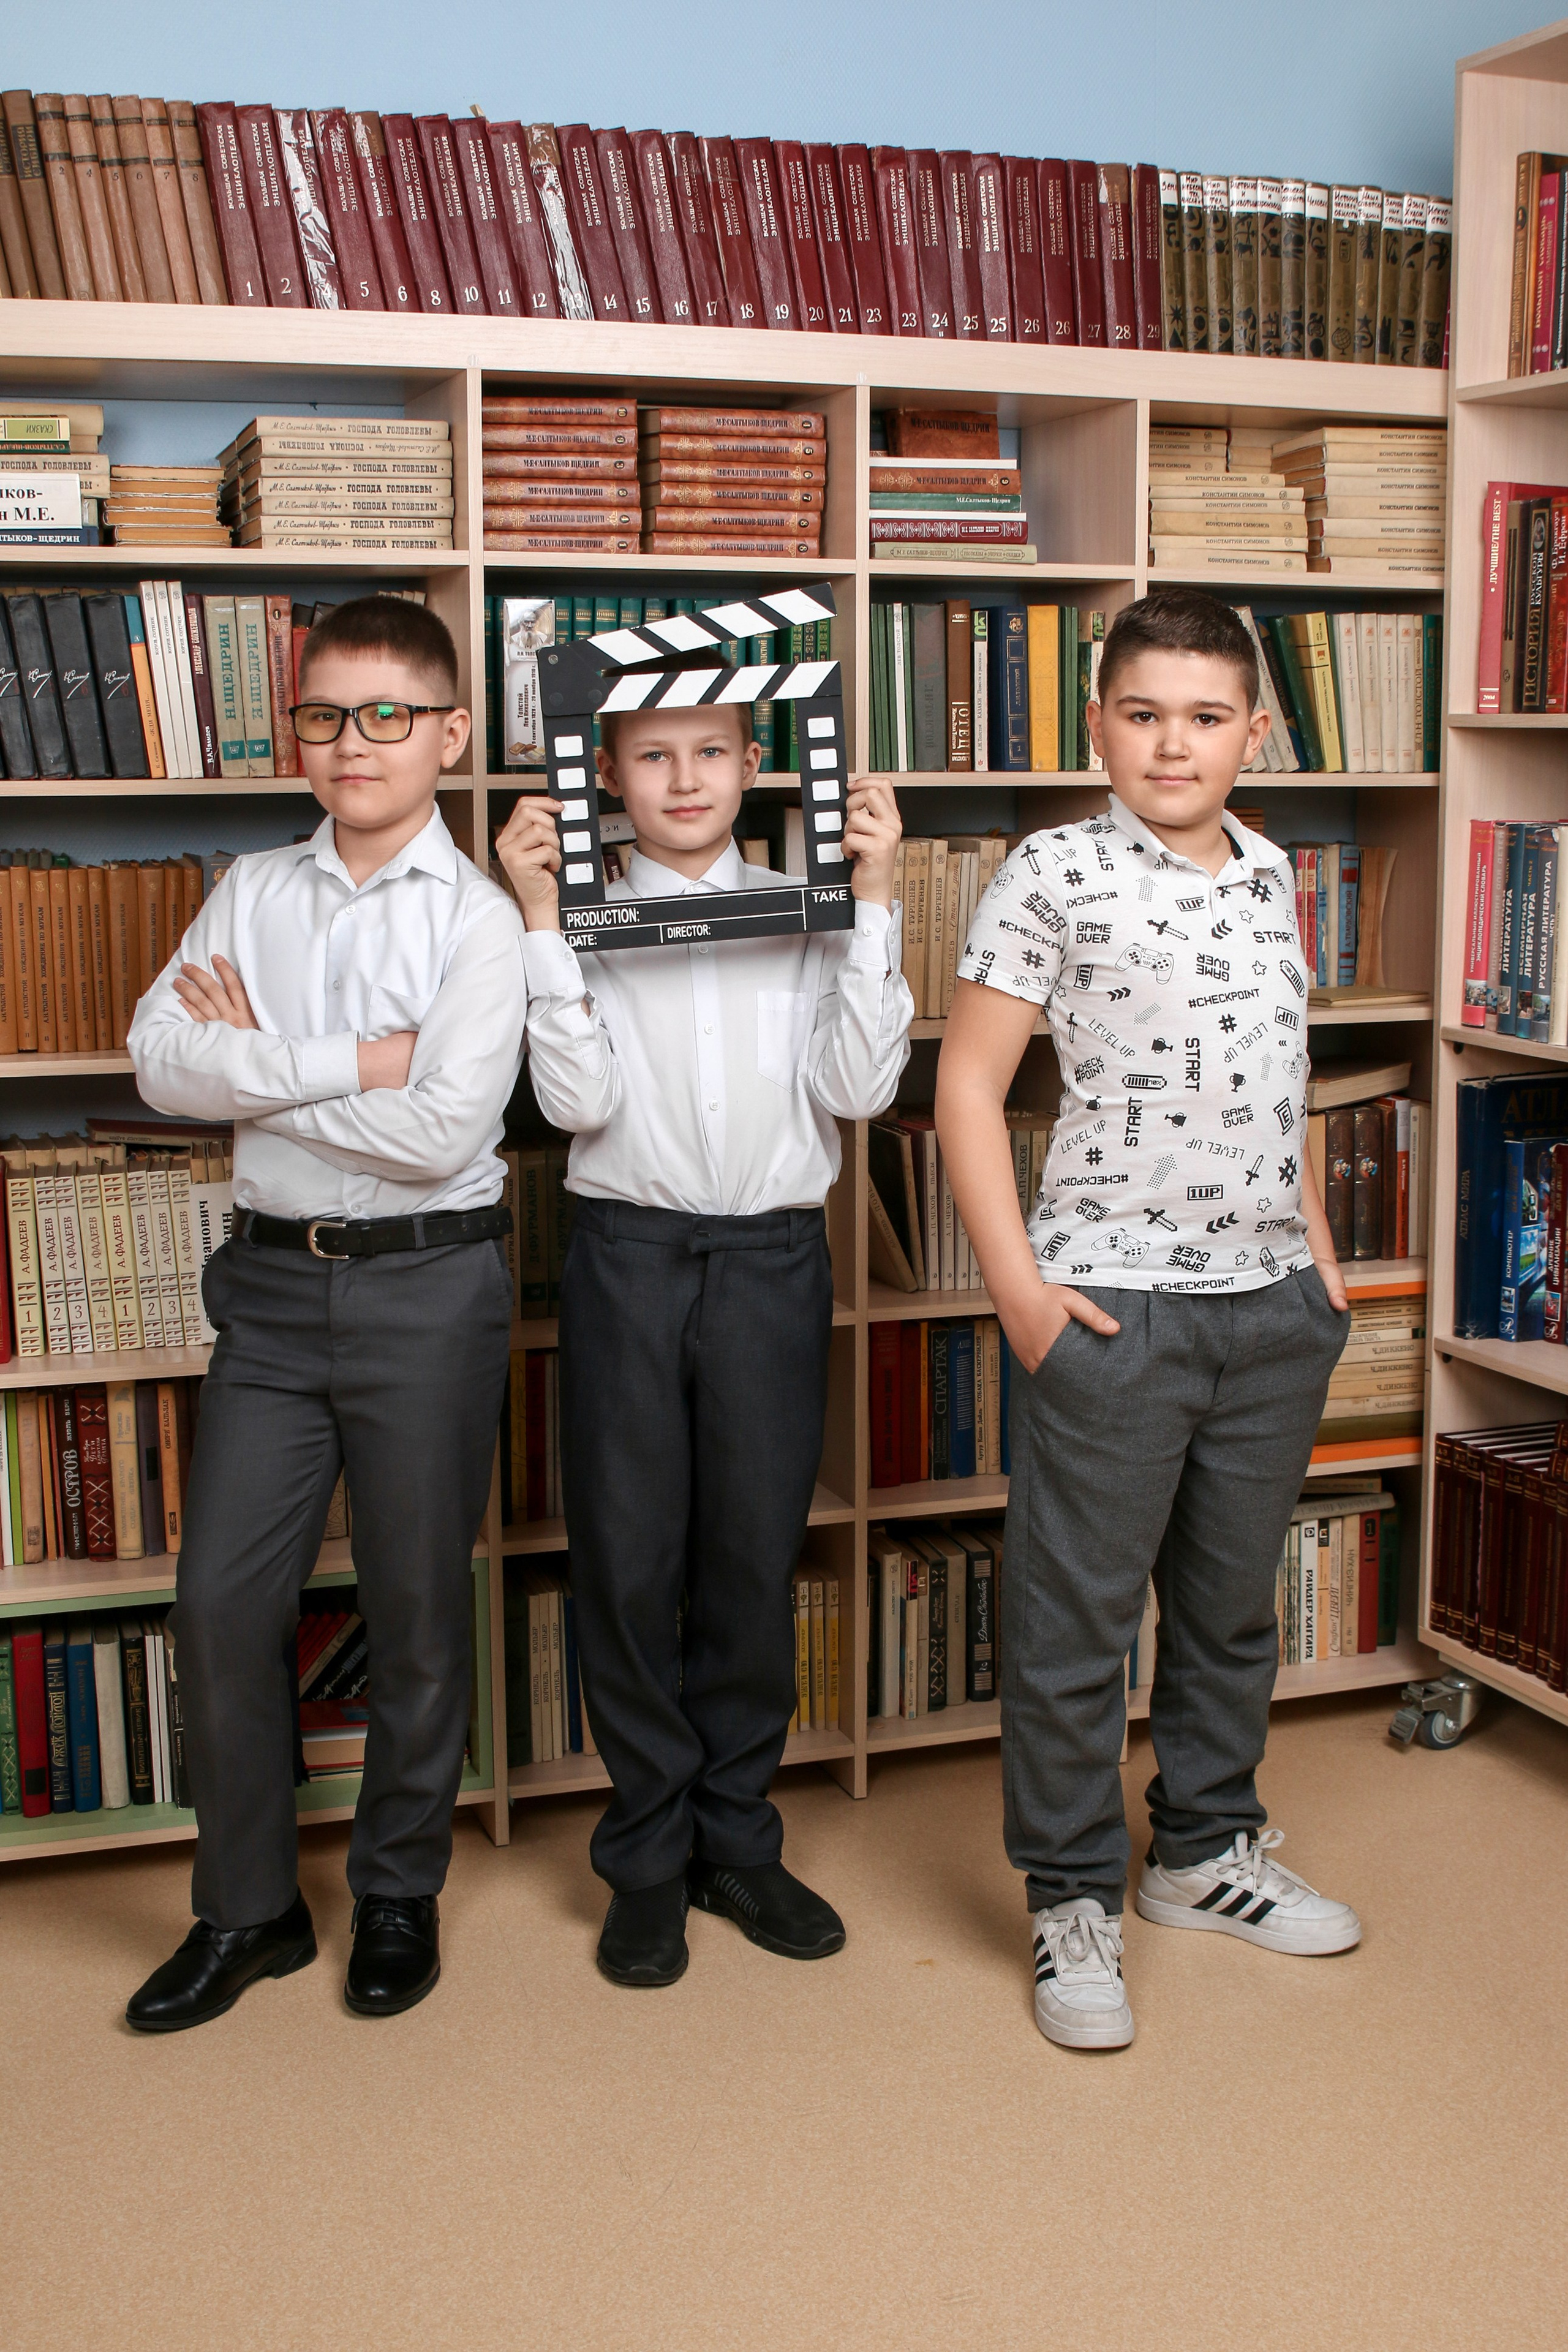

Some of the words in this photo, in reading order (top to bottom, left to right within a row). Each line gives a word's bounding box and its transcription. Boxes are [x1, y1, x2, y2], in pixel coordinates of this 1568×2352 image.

[17, 127, 32, 177] ИСТОРИЯ
[217, 125, 228, 169] СОВЕТСКАЯ
[252, 123, 263, 167] СОВЕТСКАЯ
[227, 125, 245, 209] ЭНЦИКЛОПЕДИЯ
[262, 122, 280, 206] ЭНЦИКЛОПЕДИЯ
[224, 173, 234, 209] БОЛЬШАЯ
[259, 171, 270, 207] БОЛЬШАЯ
[898, 168, 908, 245] ЭНЦИКЛОПЕДИЯ
[988, 175, 999, 252] ЭНЦИКЛОПЕДИЯ
[246, 282, 253, 297] 1
[281, 278, 292, 295] 2
[360, 282, 369, 298] 5
[398, 286, 408, 301] 6
[464, 286, 478, 302] 10
[431, 290, 441, 305] 8
[498, 289, 511, 305] 11
[532, 293, 547, 308] 12
[570, 291, 582, 309] 13
[603, 294, 617, 310] 14
[636, 298, 650, 313] 15
[674, 301, 688, 316] 16
[706, 301, 717, 316] 17
[741, 304, 755, 318] 18
[775, 304, 789, 320] 19
[809, 307, 824, 321] 20
[839, 307, 853, 322] 21
[867, 308, 881, 323] 23
[902, 312, 917, 327] 23
[932, 312, 949, 328] 24
[963, 315, 979, 330] 25
[990, 317, 1007, 332] 25
[1025, 319, 1039, 333] 26
[1056, 321, 1071, 335] 26
[1088, 325, 1100, 337] 27
[1116, 326, 1131, 339] 28
[1148, 325, 1159, 338] 29
[353, 464, 387, 473] ГОСПОДА
[347, 484, 382, 493] ГОСПОДА
[13, 507, 55, 521] М.Е.
[188, 608, 199, 643] СОЛЖЕНИЦЫН
[1525, 608, 1540, 696] ИСТОРИЯ
[192, 646, 203, 675] АЛЕКСАНДР
[812, 889, 848, 903] TAKE
[1180, 899, 1204, 909] 1UP
[1542, 861, 1551, 934] ЛИТЕРАТУРА
[567, 908, 640, 928] PRODUCTION:
[1020, 897, 1060, 933] GAME
[39, 930, 44, 940] ПО
[667, 925, 711, 939] DIRECTOR:
[1077, 921, 1113, 933] GAME
[569, 934, 597, 948] DATE:
[1077, 933, 1110, 944] OVER
[1253, 931, 1296, 944] START
[1525, 893, 1536, 978] ЛИТЕРАТУРА
[1197, 952, 1229, 971] OVER
[1539, 937, 1547, 989] РУССКАЯ
[1196, 964, 1229, 982] GAME
[1188, 989, 1260, 1008] #CHECKPOINT
[1278, 1012, 1297, 1027] 1UP
[1088, 1019, 1119, 1049] LEVEL
[1120, 1045, 1135, 1057] UP
[1236, 1022, 1268, 1050] LEVEL
[1224, 1047, 1238, 1063] UP
[1185, 1038, 1200, 1092] START
[1222, 1104, 1253, 1118] GAME
[1124, 1097, 1142, 1147] START
[1224, 1114, 1254, 1128] OVER
[1061, 1129, 1092, 1154] LEVEL
[1093, 1120, 1106, 1134] UP
[1186, 1139, 1202, 1150] UP
[1207, 1142, 1245, 1160] LEVEL
[1019, 1145, 1027, 1199] А.П.ЧЕХОВ
[1056, 1174, 1128, 1186] #CHECKPOINT
[1190, 1188, 1220, 1198] 1UP
[1461, 1170, 1470, 1200] МИРА
[1076, 1206, 1102, 1223] OVER
[1080, 1197, 1111, 1216] GAME
[1460, 1204, 1469, 1240] АТЛАС
[18, 1220, 29, 1264] ФАДЕЕВ
[45, 1218, 57, 1261] ФАДЕЕВ
[113, 1215, 126, 1257] ФАДЕЕВ
[1048, 1234, 1067, 1257] 1UP
[1172, 1245, 1211, 1263] OVER
[1166, 1255, 1205, 1272] GAME
[1152, 1277, 1235, 1292] #CHECKPOINT
[26, 1310, 31, 1322] 1
[54, 1307, 61, 1320] 2
[935, 1337, 947, 1414] СПАРТАК
[62, 1449, 81, 1507] ОСТРОВ
